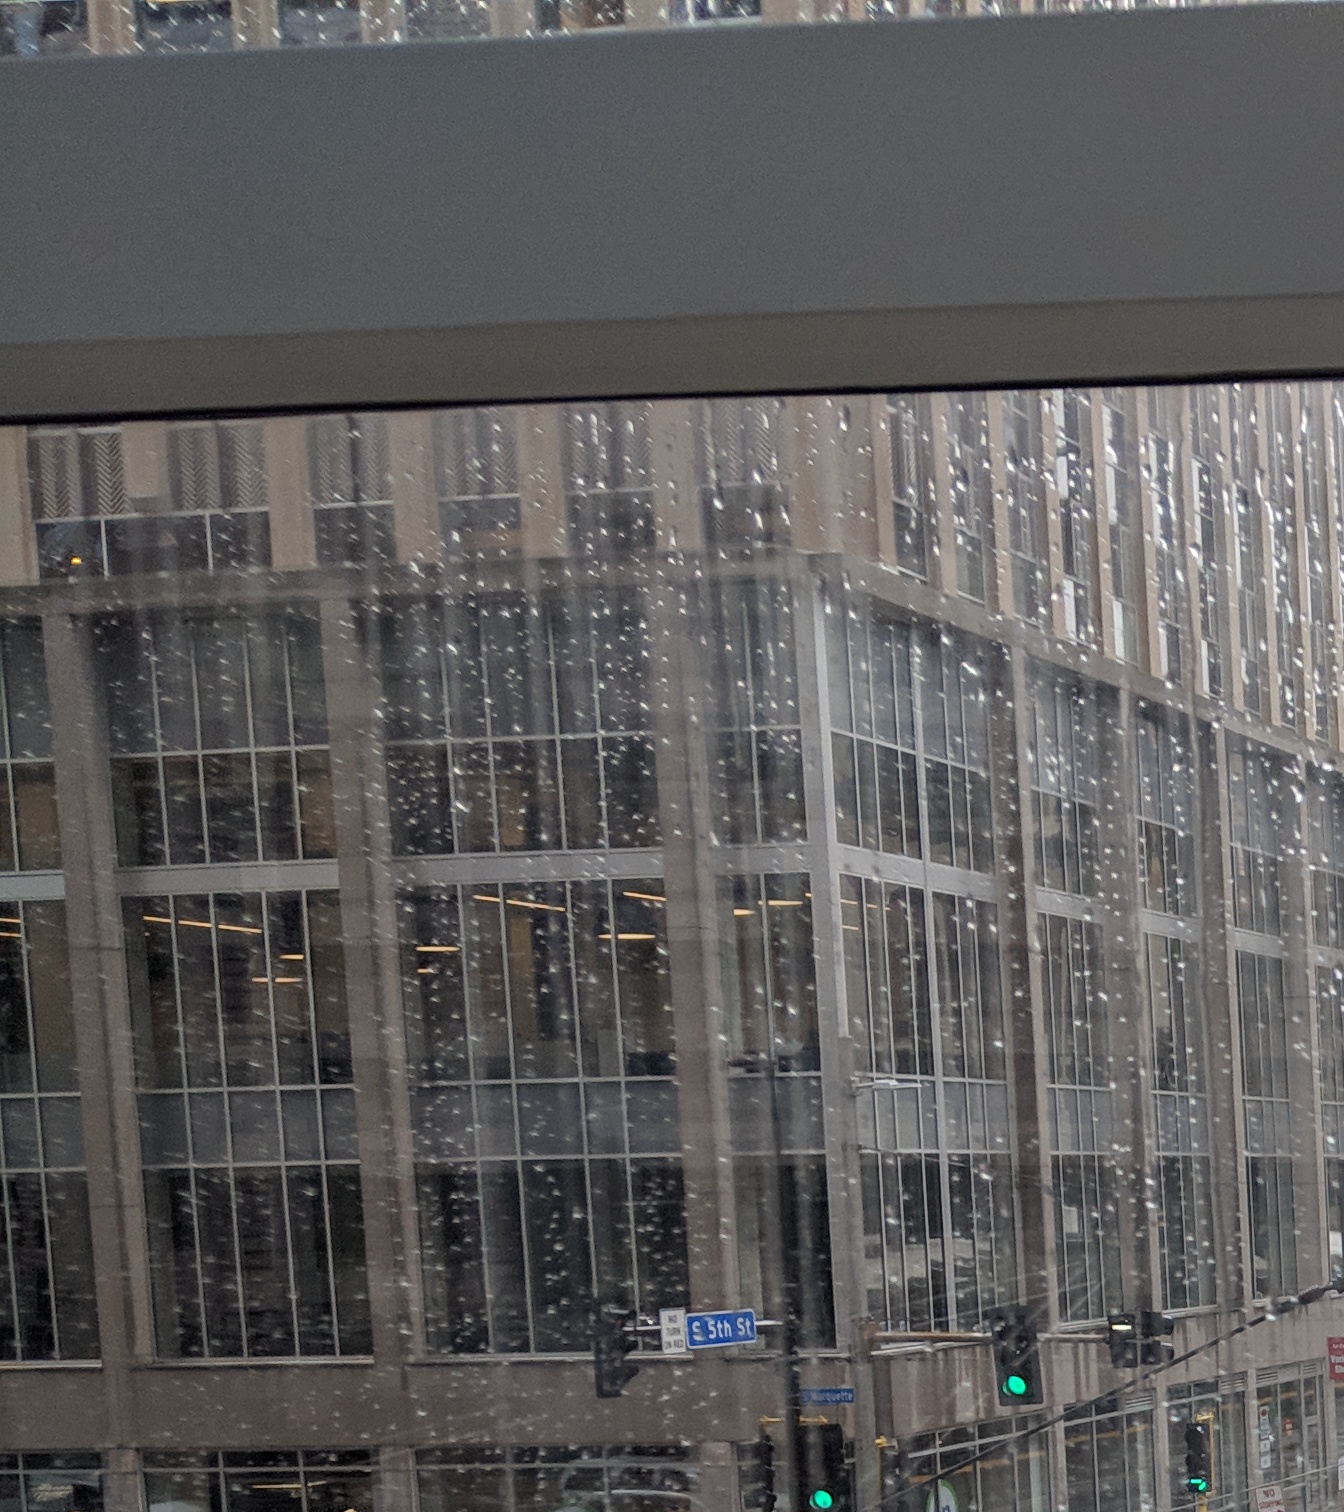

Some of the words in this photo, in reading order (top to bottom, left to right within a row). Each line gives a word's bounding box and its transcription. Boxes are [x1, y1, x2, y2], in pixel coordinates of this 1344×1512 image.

[691, 1320, 705, 1341] S
[707, 1319, 732, 1340] 5th
[736, 1317, 755, 1337] St
